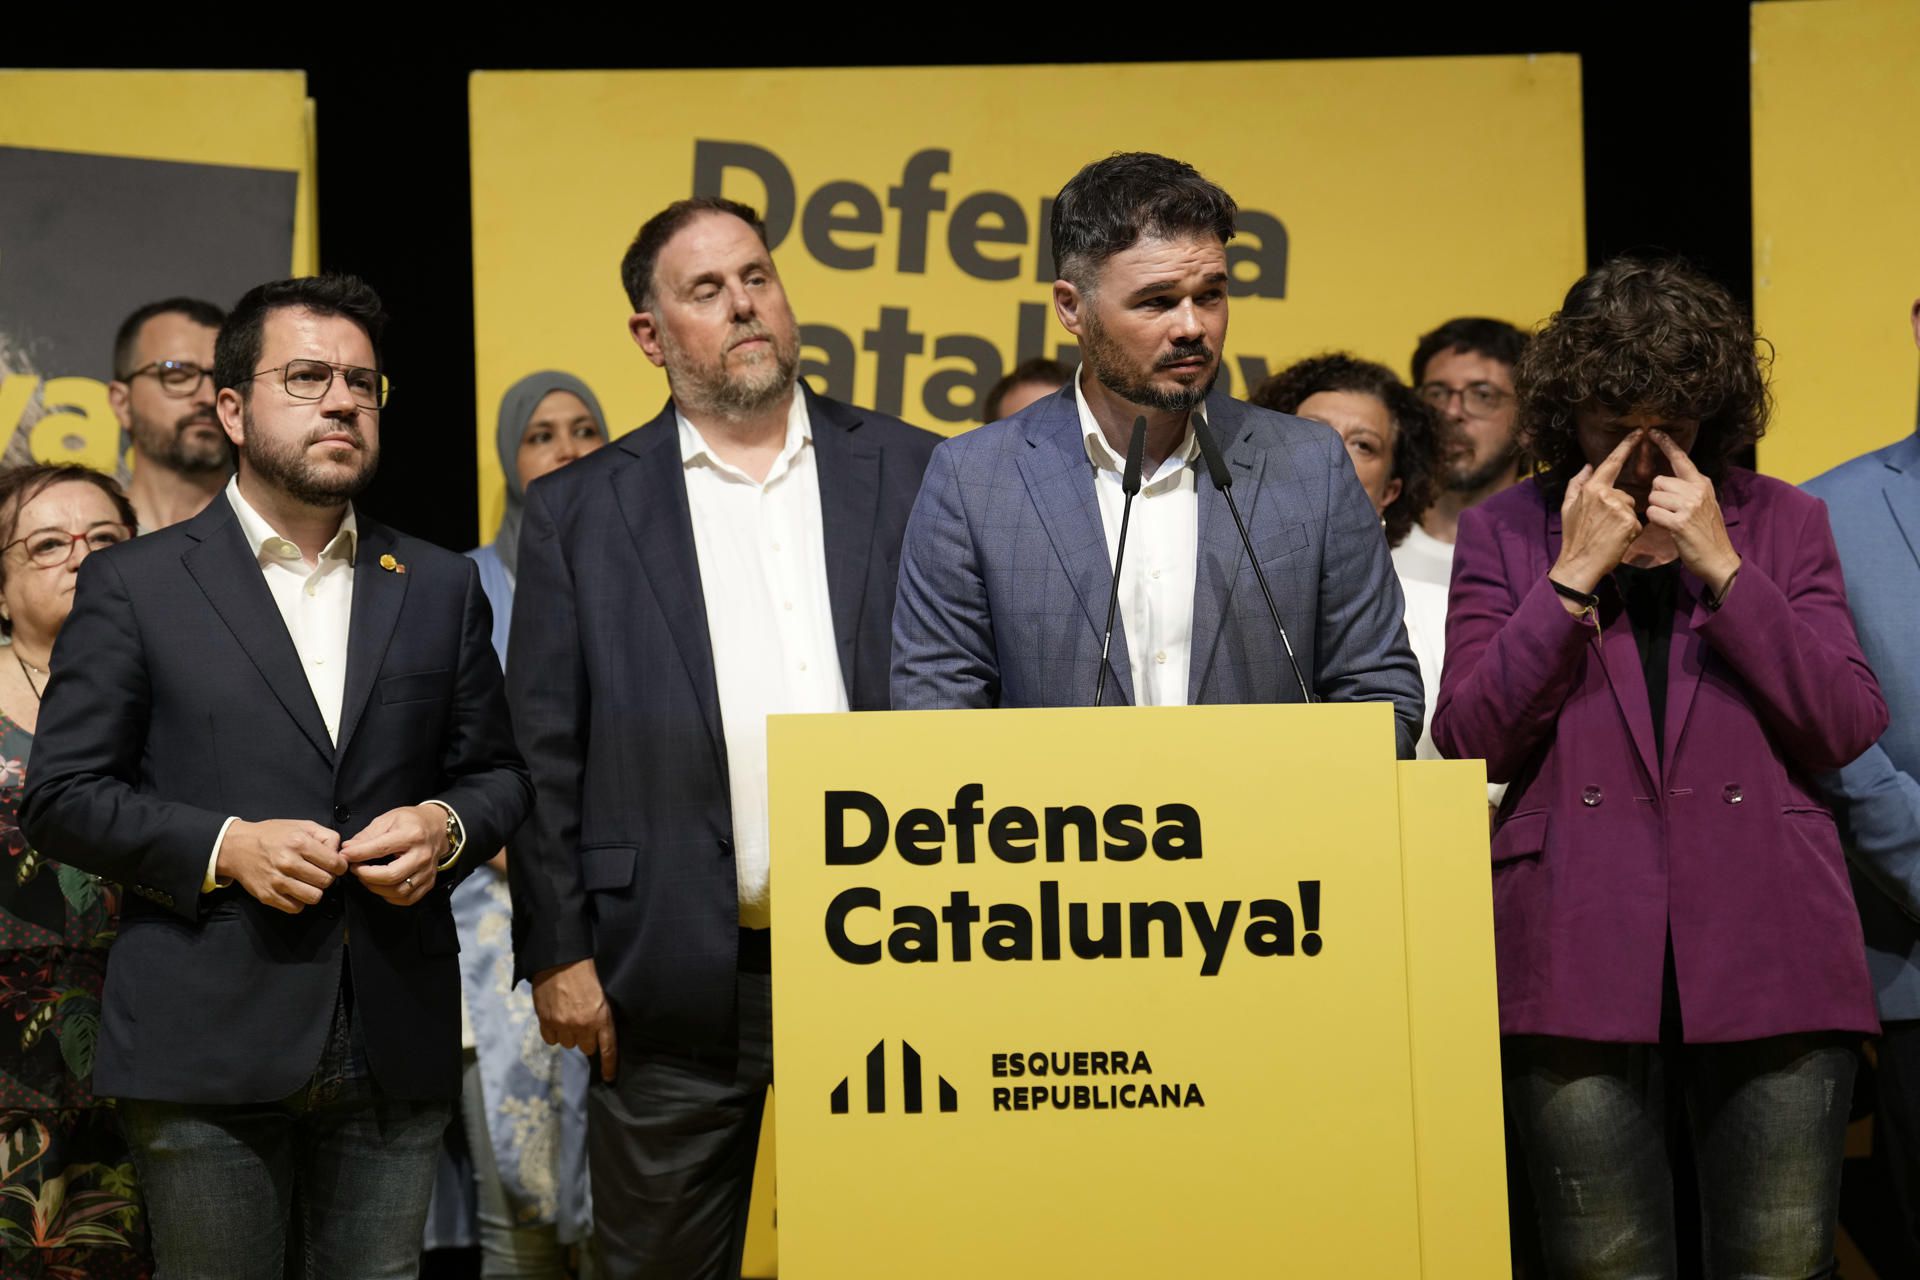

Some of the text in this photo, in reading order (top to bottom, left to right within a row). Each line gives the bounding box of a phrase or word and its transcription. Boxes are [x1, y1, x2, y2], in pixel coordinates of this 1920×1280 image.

[692, 138, 1289, 300] Defea
[824, 783, 1203, 866] Defensa
[824, 880, 1323, 977] Catalunya!
[991, 1050, 1153, 1078] ESQUERRA
[992, 1083, 1205, 1112] REPUBLICANA
